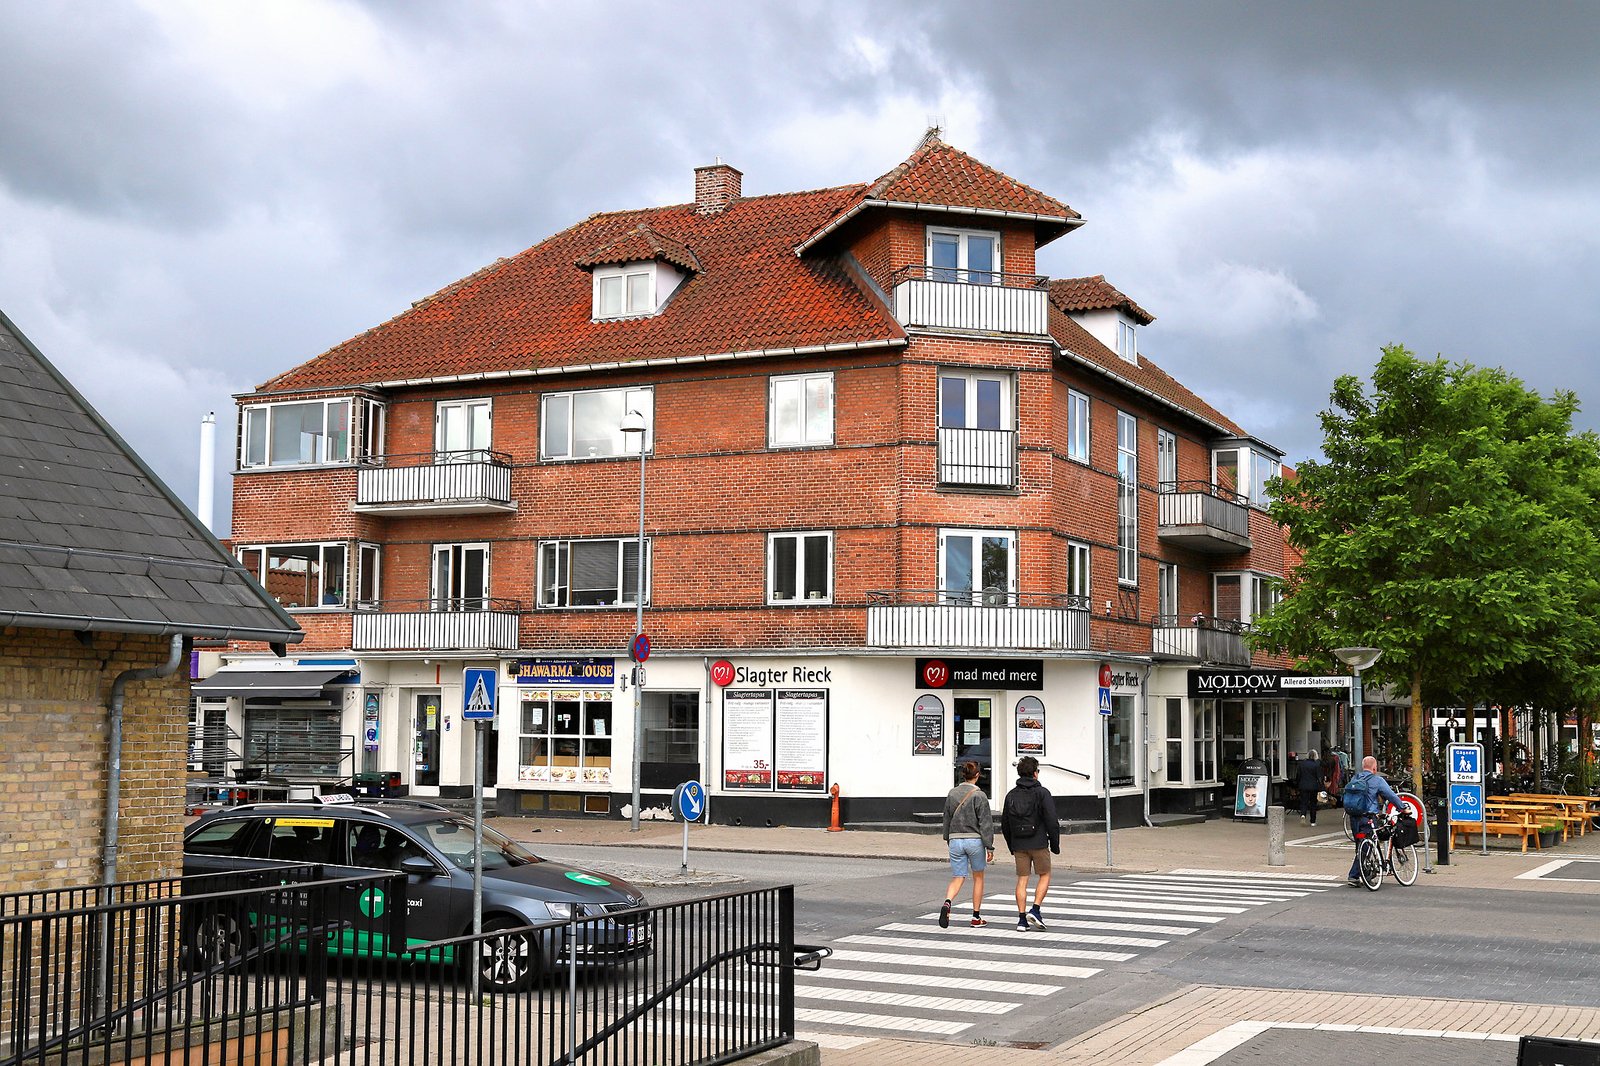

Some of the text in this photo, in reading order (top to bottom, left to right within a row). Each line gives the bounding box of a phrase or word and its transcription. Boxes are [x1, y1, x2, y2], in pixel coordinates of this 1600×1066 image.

[517, 665, 574, 677] SHAWARMA
[736, 666, 832, 686] Slagter Rieck
[953, 668, 1038, 681] mad med mere
[1198, 675, 1277, 688] MOLDOW
[1308, 678, 1345, 687] Stationsvej
[733, 691, 766, 699] Slagtertapas
[784, 691, 818, 699] Slagtertapas
[753, 759, 769, 769] 35,-
